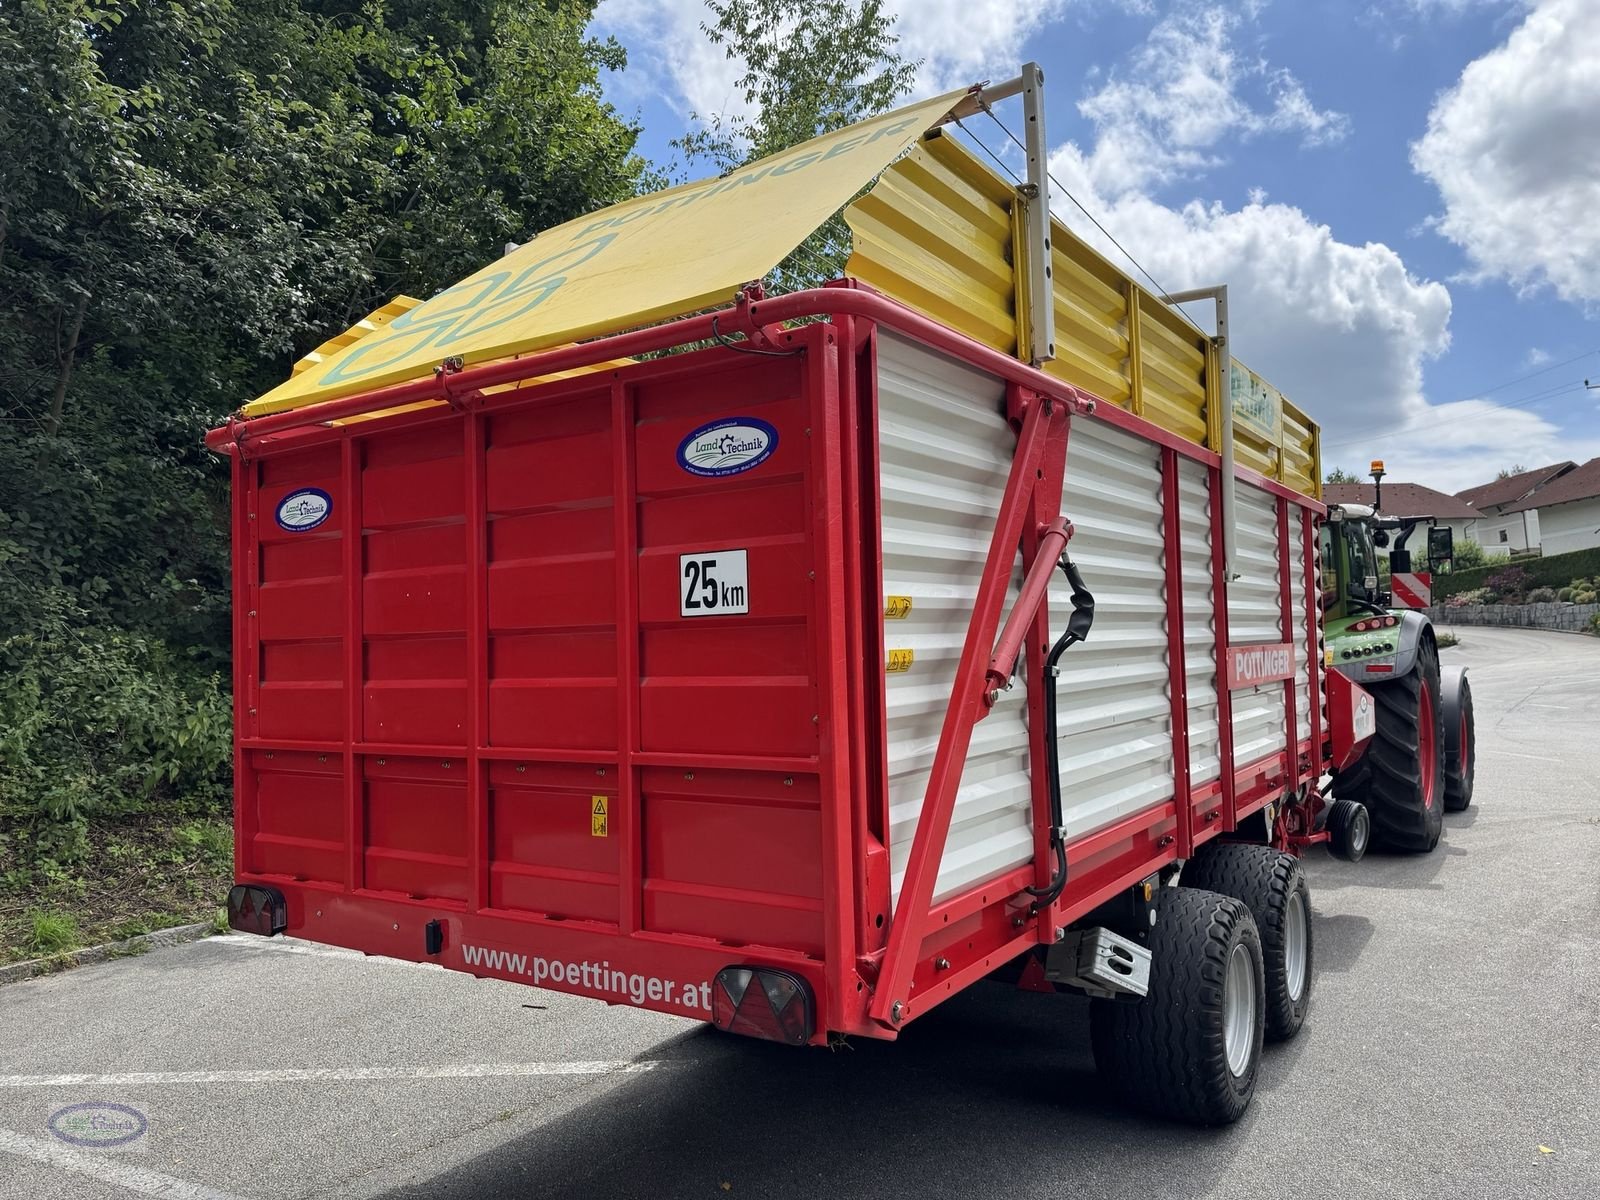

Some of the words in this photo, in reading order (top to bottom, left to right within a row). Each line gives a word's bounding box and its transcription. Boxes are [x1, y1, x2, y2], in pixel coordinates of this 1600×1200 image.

[695, 438, 718, 453] Land
[726, 437, 763, 454] Technik
[685, 560, 718, 609] 25
[722, 581, 744, 607] km
[462, 944, 712, 1011] www.poettinger.at
